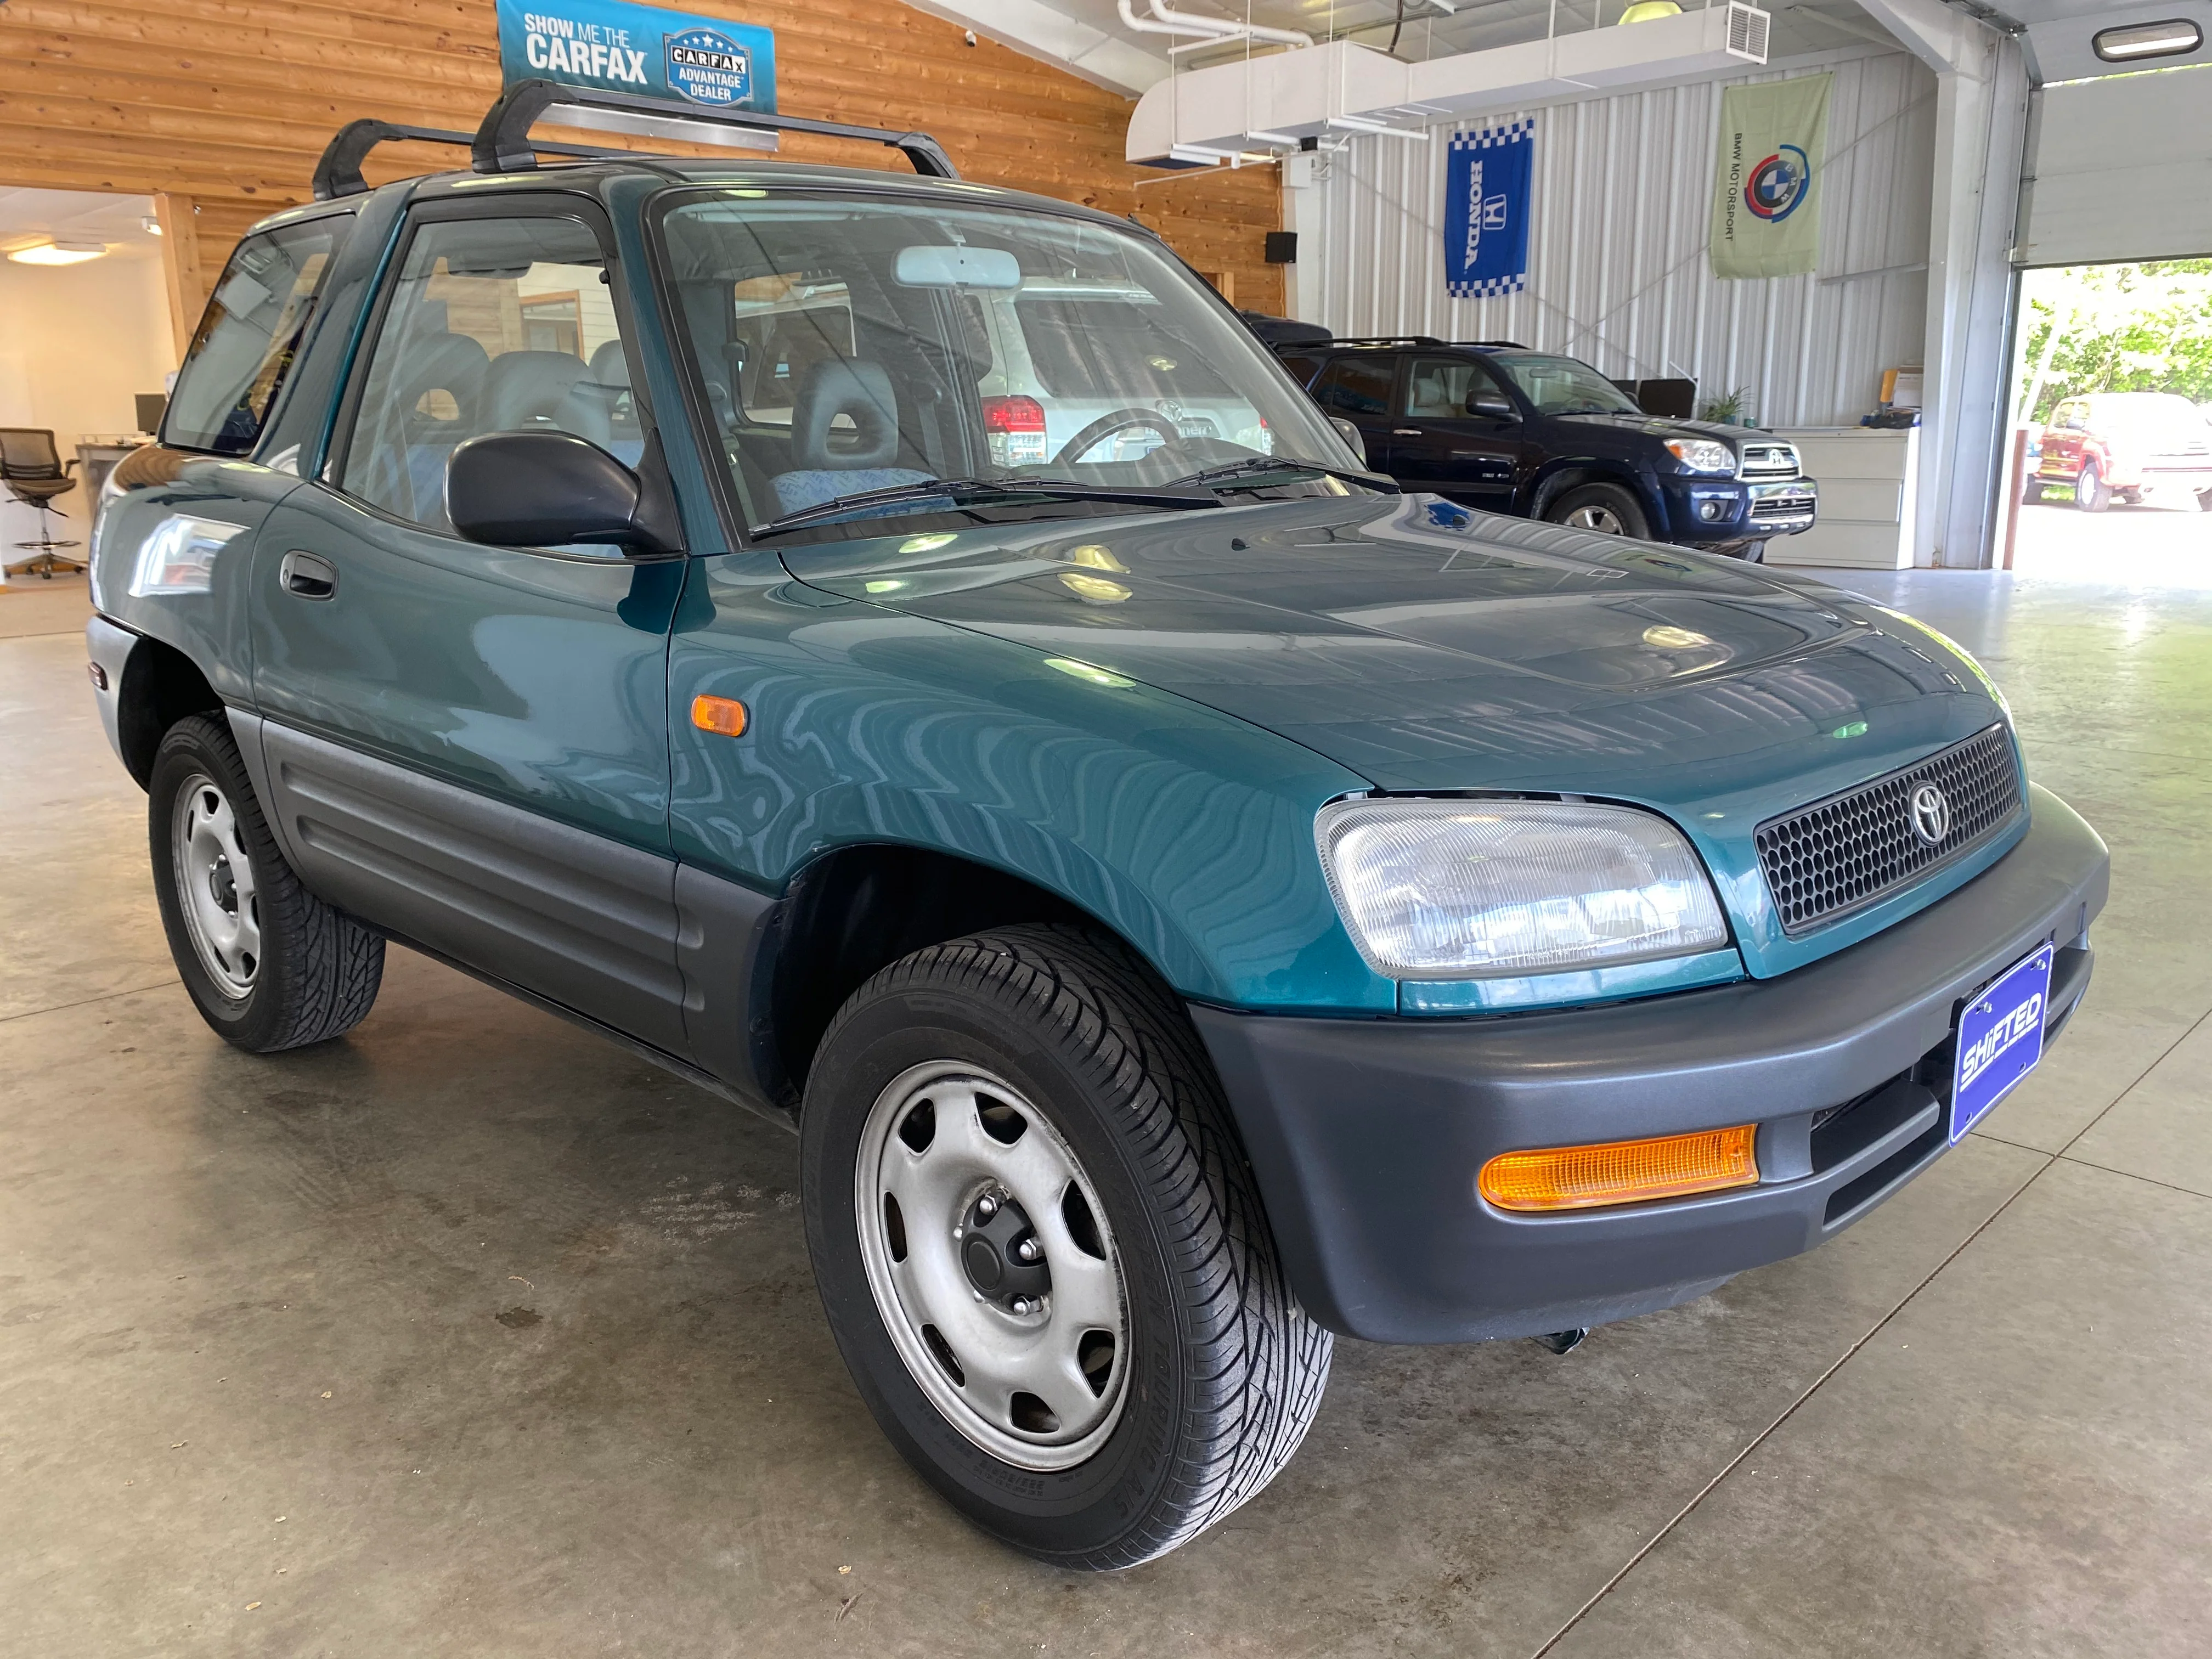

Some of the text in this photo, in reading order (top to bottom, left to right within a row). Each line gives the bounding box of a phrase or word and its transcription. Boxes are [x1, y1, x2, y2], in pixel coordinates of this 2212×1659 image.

[524, 13, 630, 48] SHOW ME THE
[526, 33, 648, 84] CARFAX
[673, 48, 743, 72] CARFAX
[679, 67, 741, 88] ADVANTAGE
[690, 83, 732, 101] DEALER
[1725, 132, 1743, 241] BMW MOTORSPORT
[1464, 160, 1483, 270] HONDA
[1139, 1338, 1172, 1475] TOURING
